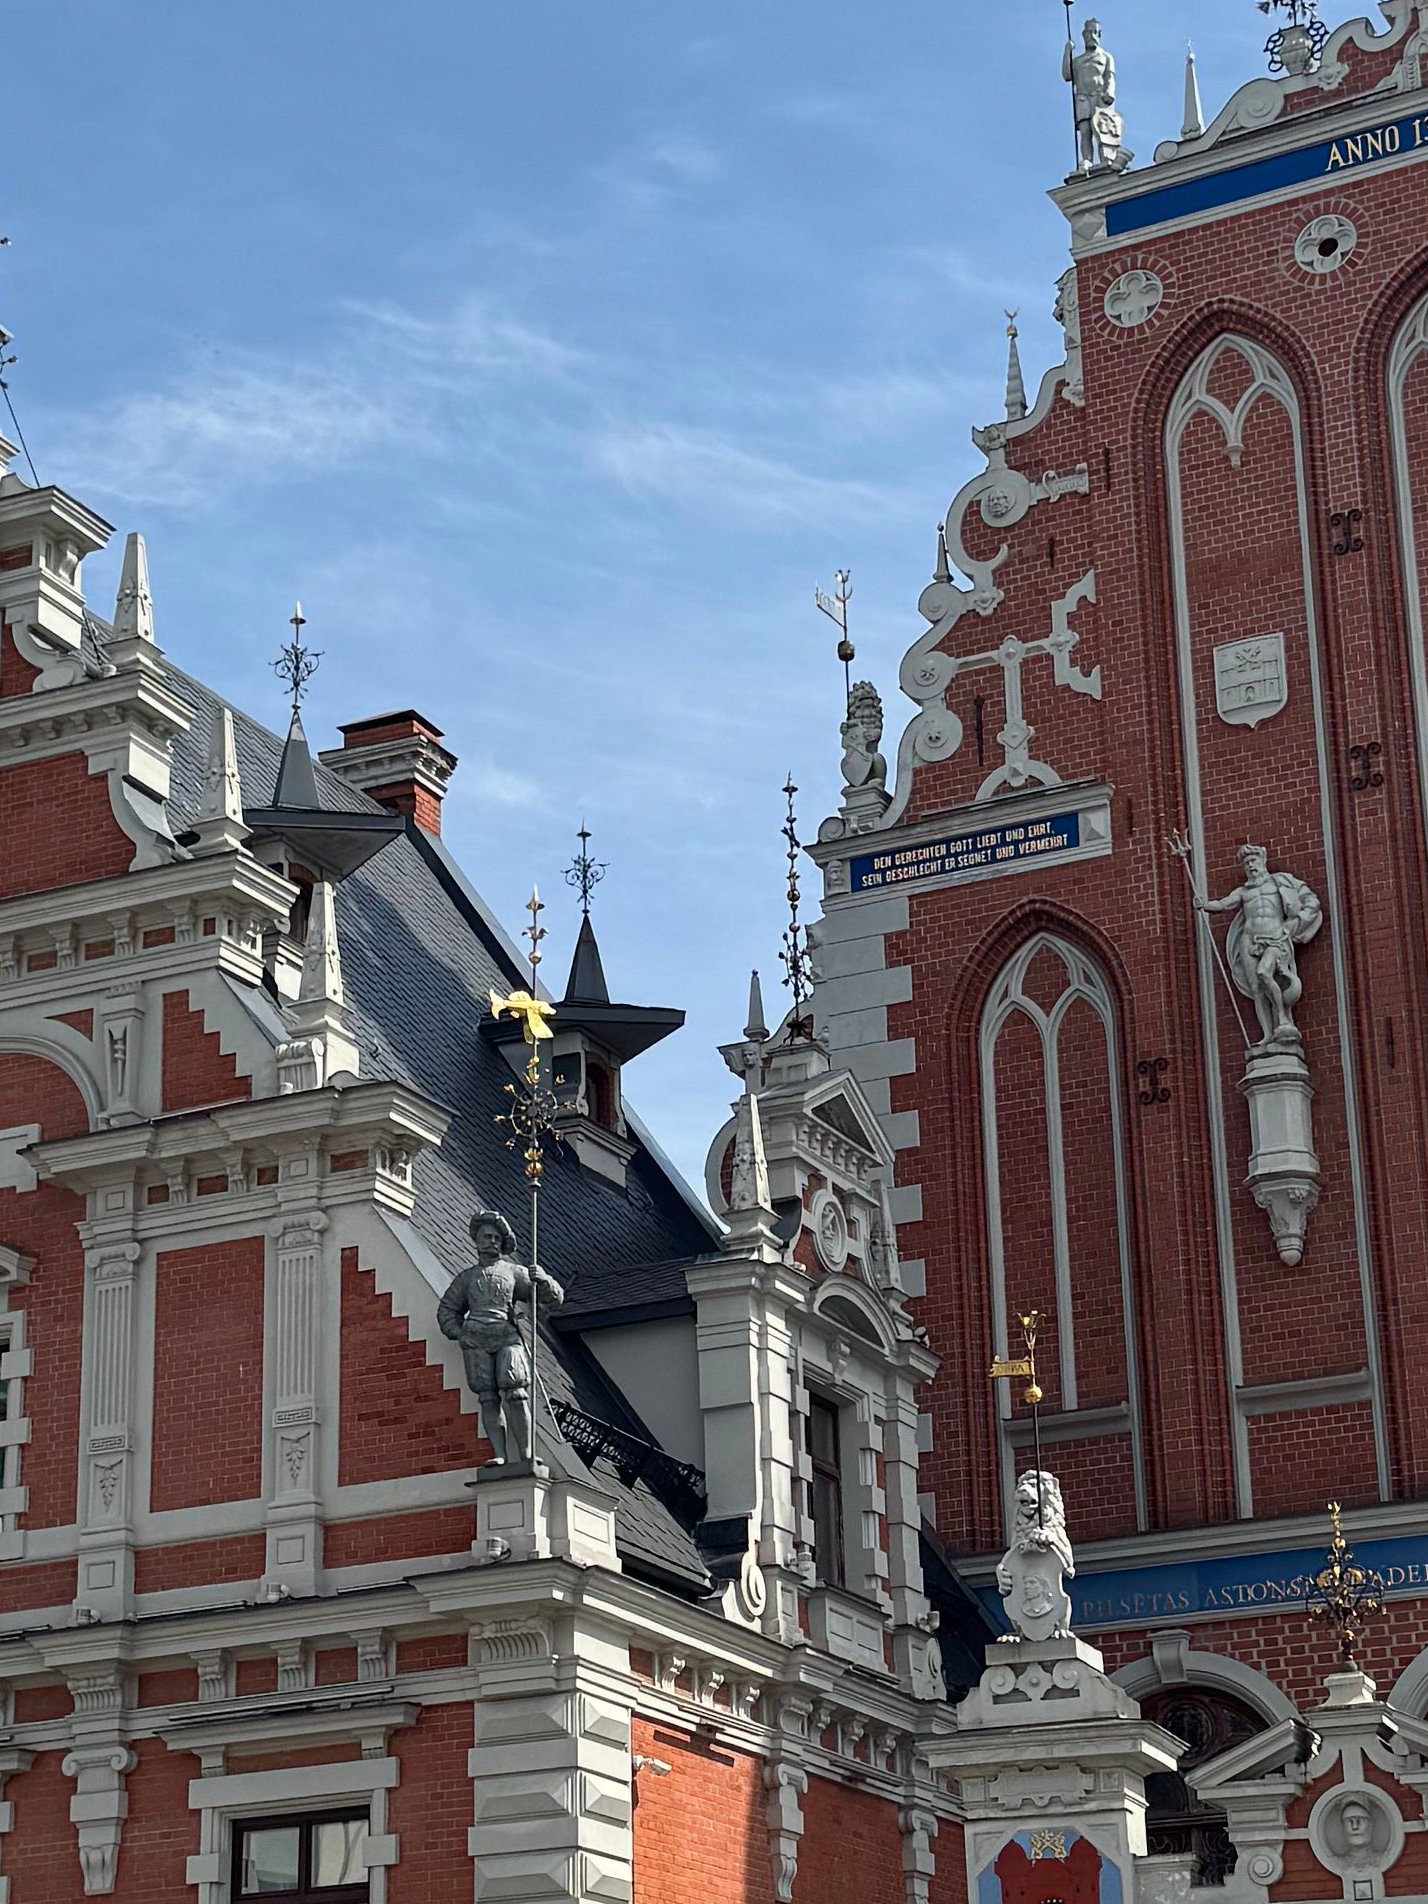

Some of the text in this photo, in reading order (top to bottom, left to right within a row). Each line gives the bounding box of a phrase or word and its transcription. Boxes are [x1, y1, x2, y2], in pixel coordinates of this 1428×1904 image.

[1325, 125, 1400, 172] ANNO
[862, 833, 1069, 887] SEIN GESCHLECHT ER SEGNET UND VERMEHRT
[874, 855, 892, 871] DEN
[895, 844, 947, 865] GERECHTEN
[950, 838, 974, 854] GOTT
[1005, 828, 1025, 843] UND
